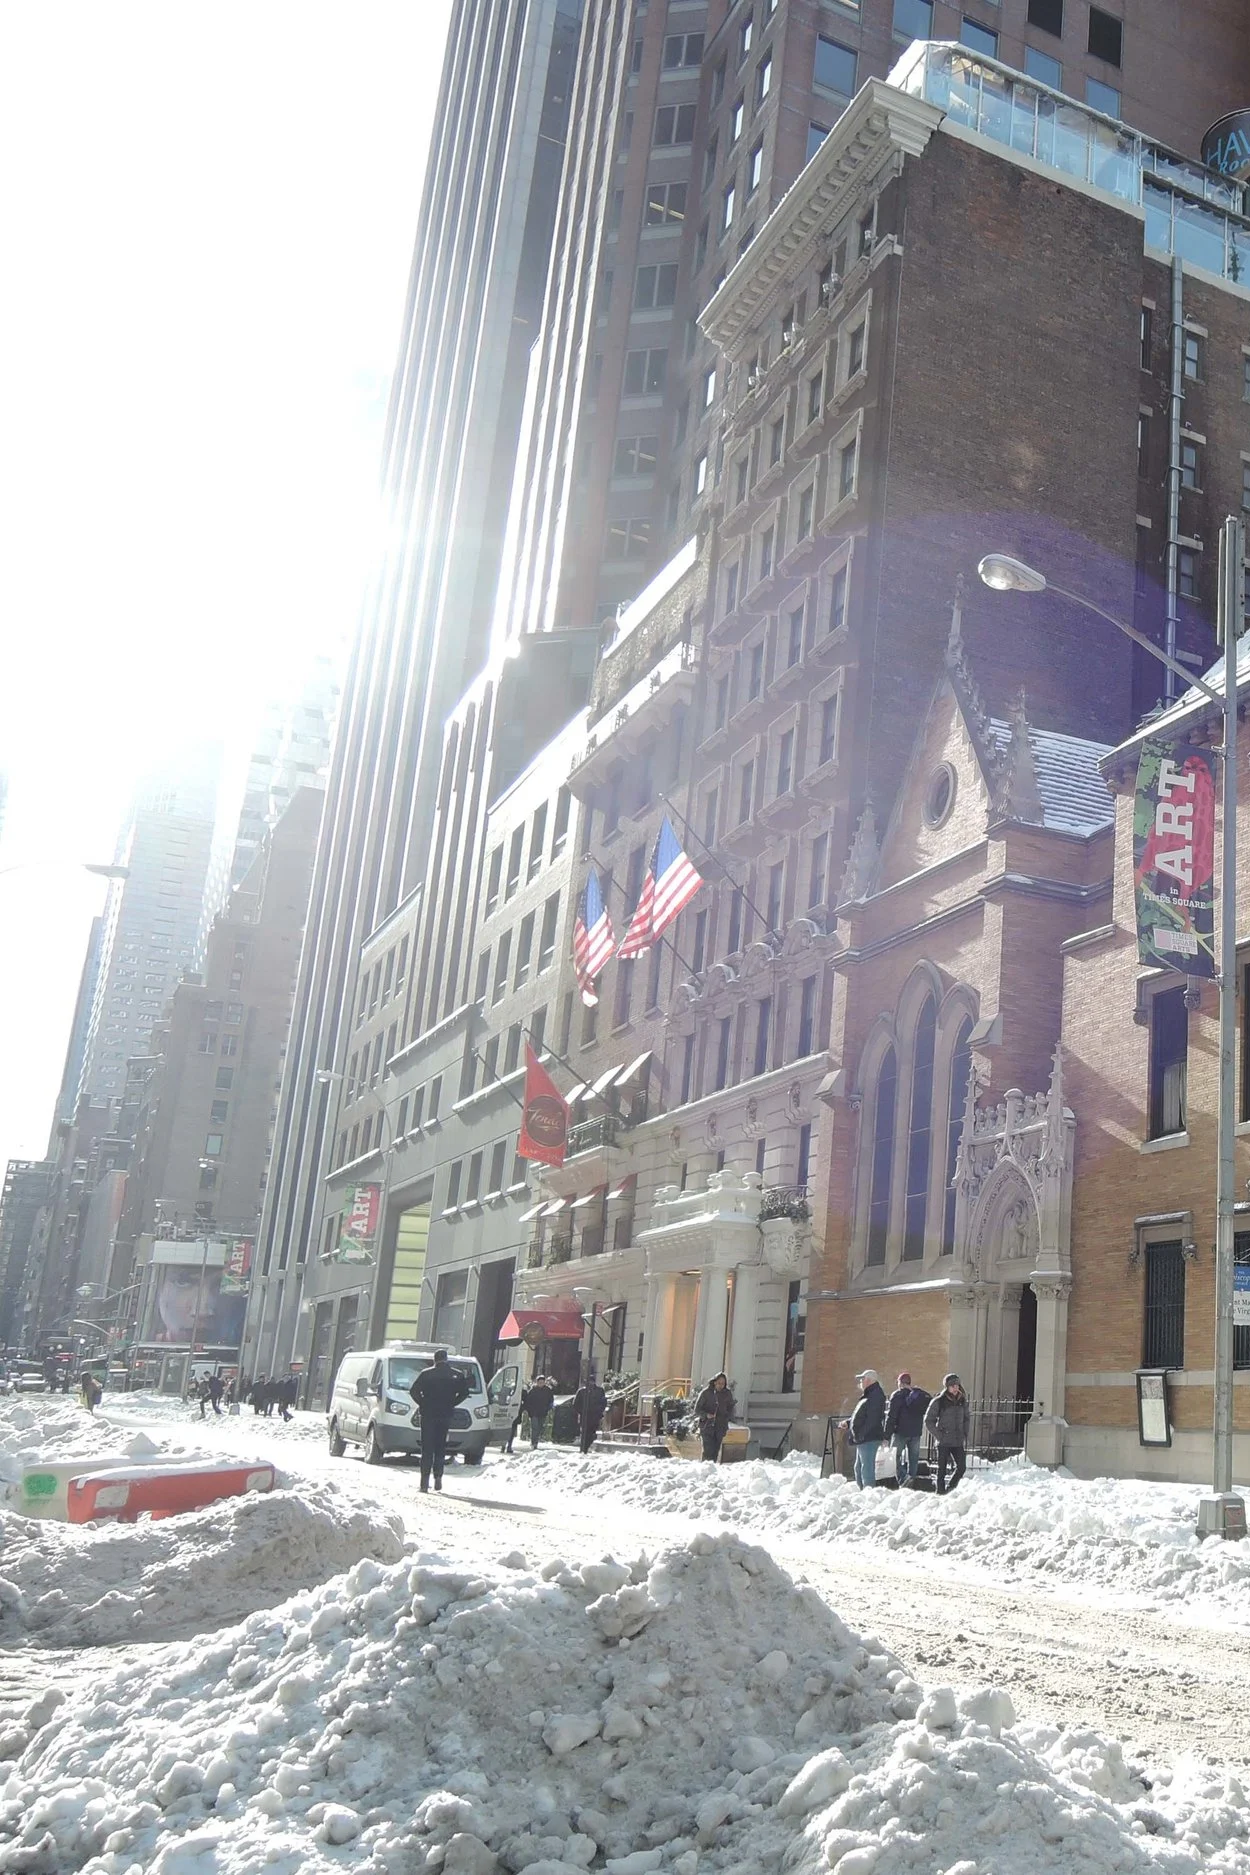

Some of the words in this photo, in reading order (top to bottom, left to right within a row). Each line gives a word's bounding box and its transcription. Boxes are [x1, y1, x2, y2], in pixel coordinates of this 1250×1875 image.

[1155, 758, 1196, 886] ART
[1143, 892, 1171, 904] TIMES
[1172, 897, 1206, 909] SQUARE
[1170, 886, 1179, 895] in
[351, 1188, 372, 1234] ART
[230, 1240, 246, 1273] ART
